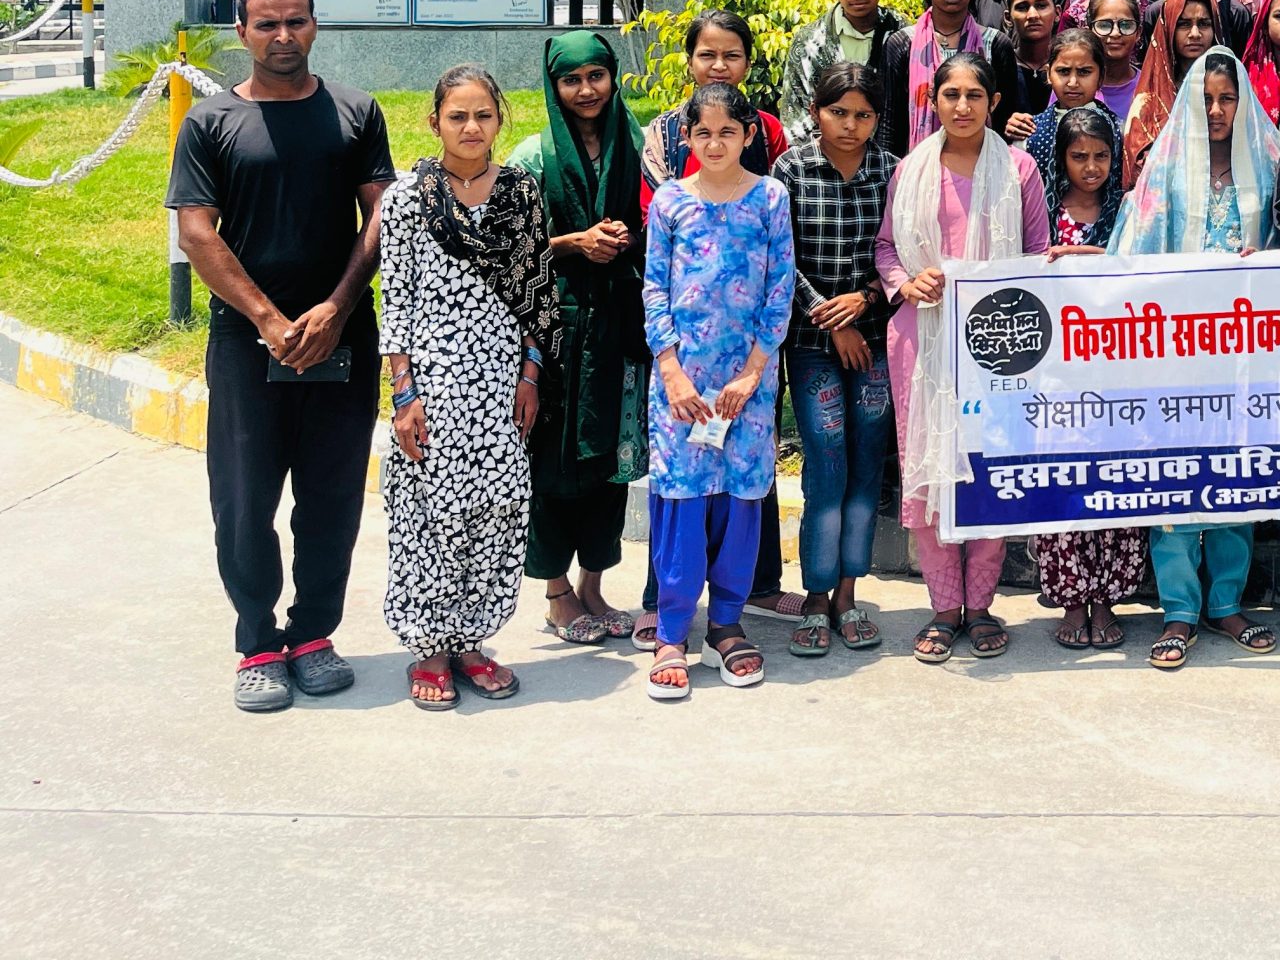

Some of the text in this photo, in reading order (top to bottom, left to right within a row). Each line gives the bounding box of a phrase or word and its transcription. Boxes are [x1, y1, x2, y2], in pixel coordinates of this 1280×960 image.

[1060, 302, 1167, 362] किशोरी
[990, 377, 1032, 392] F.E.D.
[1022, 391, 1147, 428] शैक्षणिक
[1158, 393, 1235, 423] भ्रमण
[987, 461, 1091, 500] दूसरा
[1096, 455, 1202, 483] दशक
[1083, 488, 1194, 511] पीसांगन
